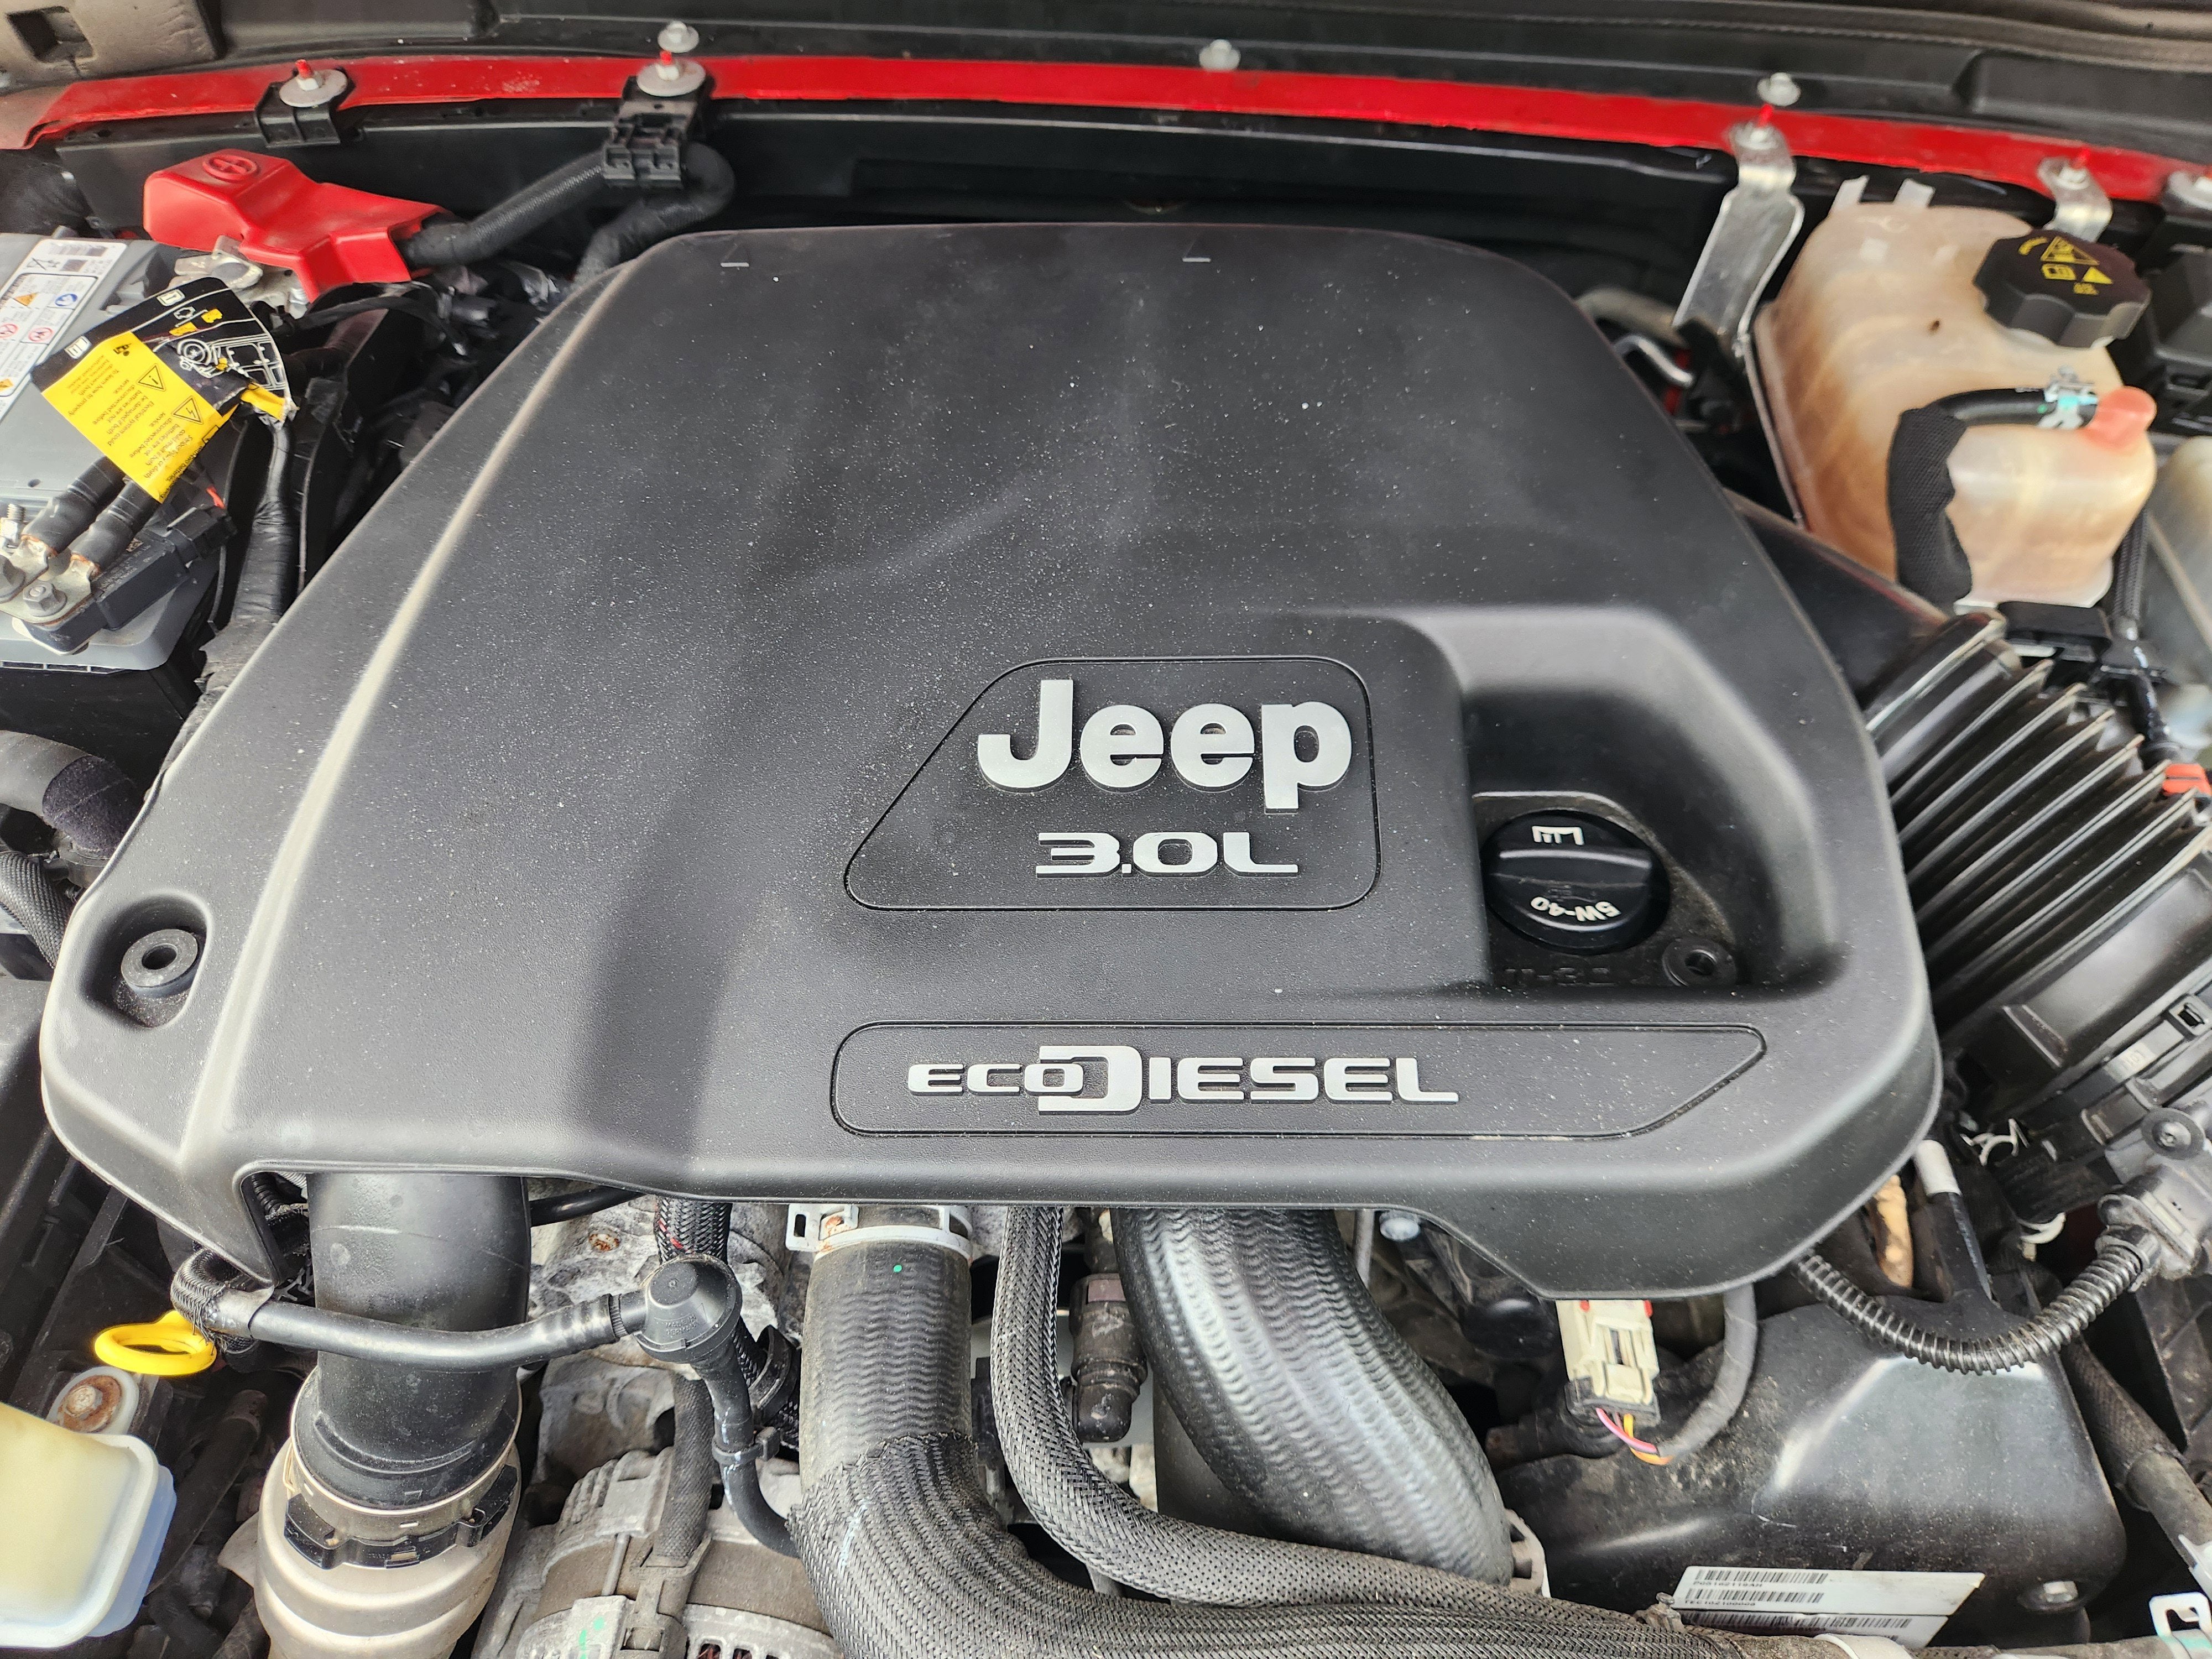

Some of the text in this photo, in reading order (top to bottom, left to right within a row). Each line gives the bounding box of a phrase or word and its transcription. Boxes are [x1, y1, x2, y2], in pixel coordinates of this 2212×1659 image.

[78, 363, 113, 396] disconnect both
[101, 373, 113, 385] learn
[67, 397, 87, 417] properly
[92, 384, 136, 426] disconnected before
[122, 389, 142, 409] batteries
[120, 400, 142, 421] damaged
[106, 423, 119, 435] both
[107, 400, 154, 447] Electrical system could
[159, 422, 180, 442] batteries
[129, 417, 173, 458] disconnected before
[171, 428, 186, 442] could
[175, 434, 193, 451] Serious
[159, 440, 173, 453] result
[145, 454, 158, 467] both
[143, 465, 159, 479] death
[977, 679, 1352, 813] Jeep
[1036, 832, 1298, 877] 3.0L
[1530, 895, 1622, 922] 5W-40
